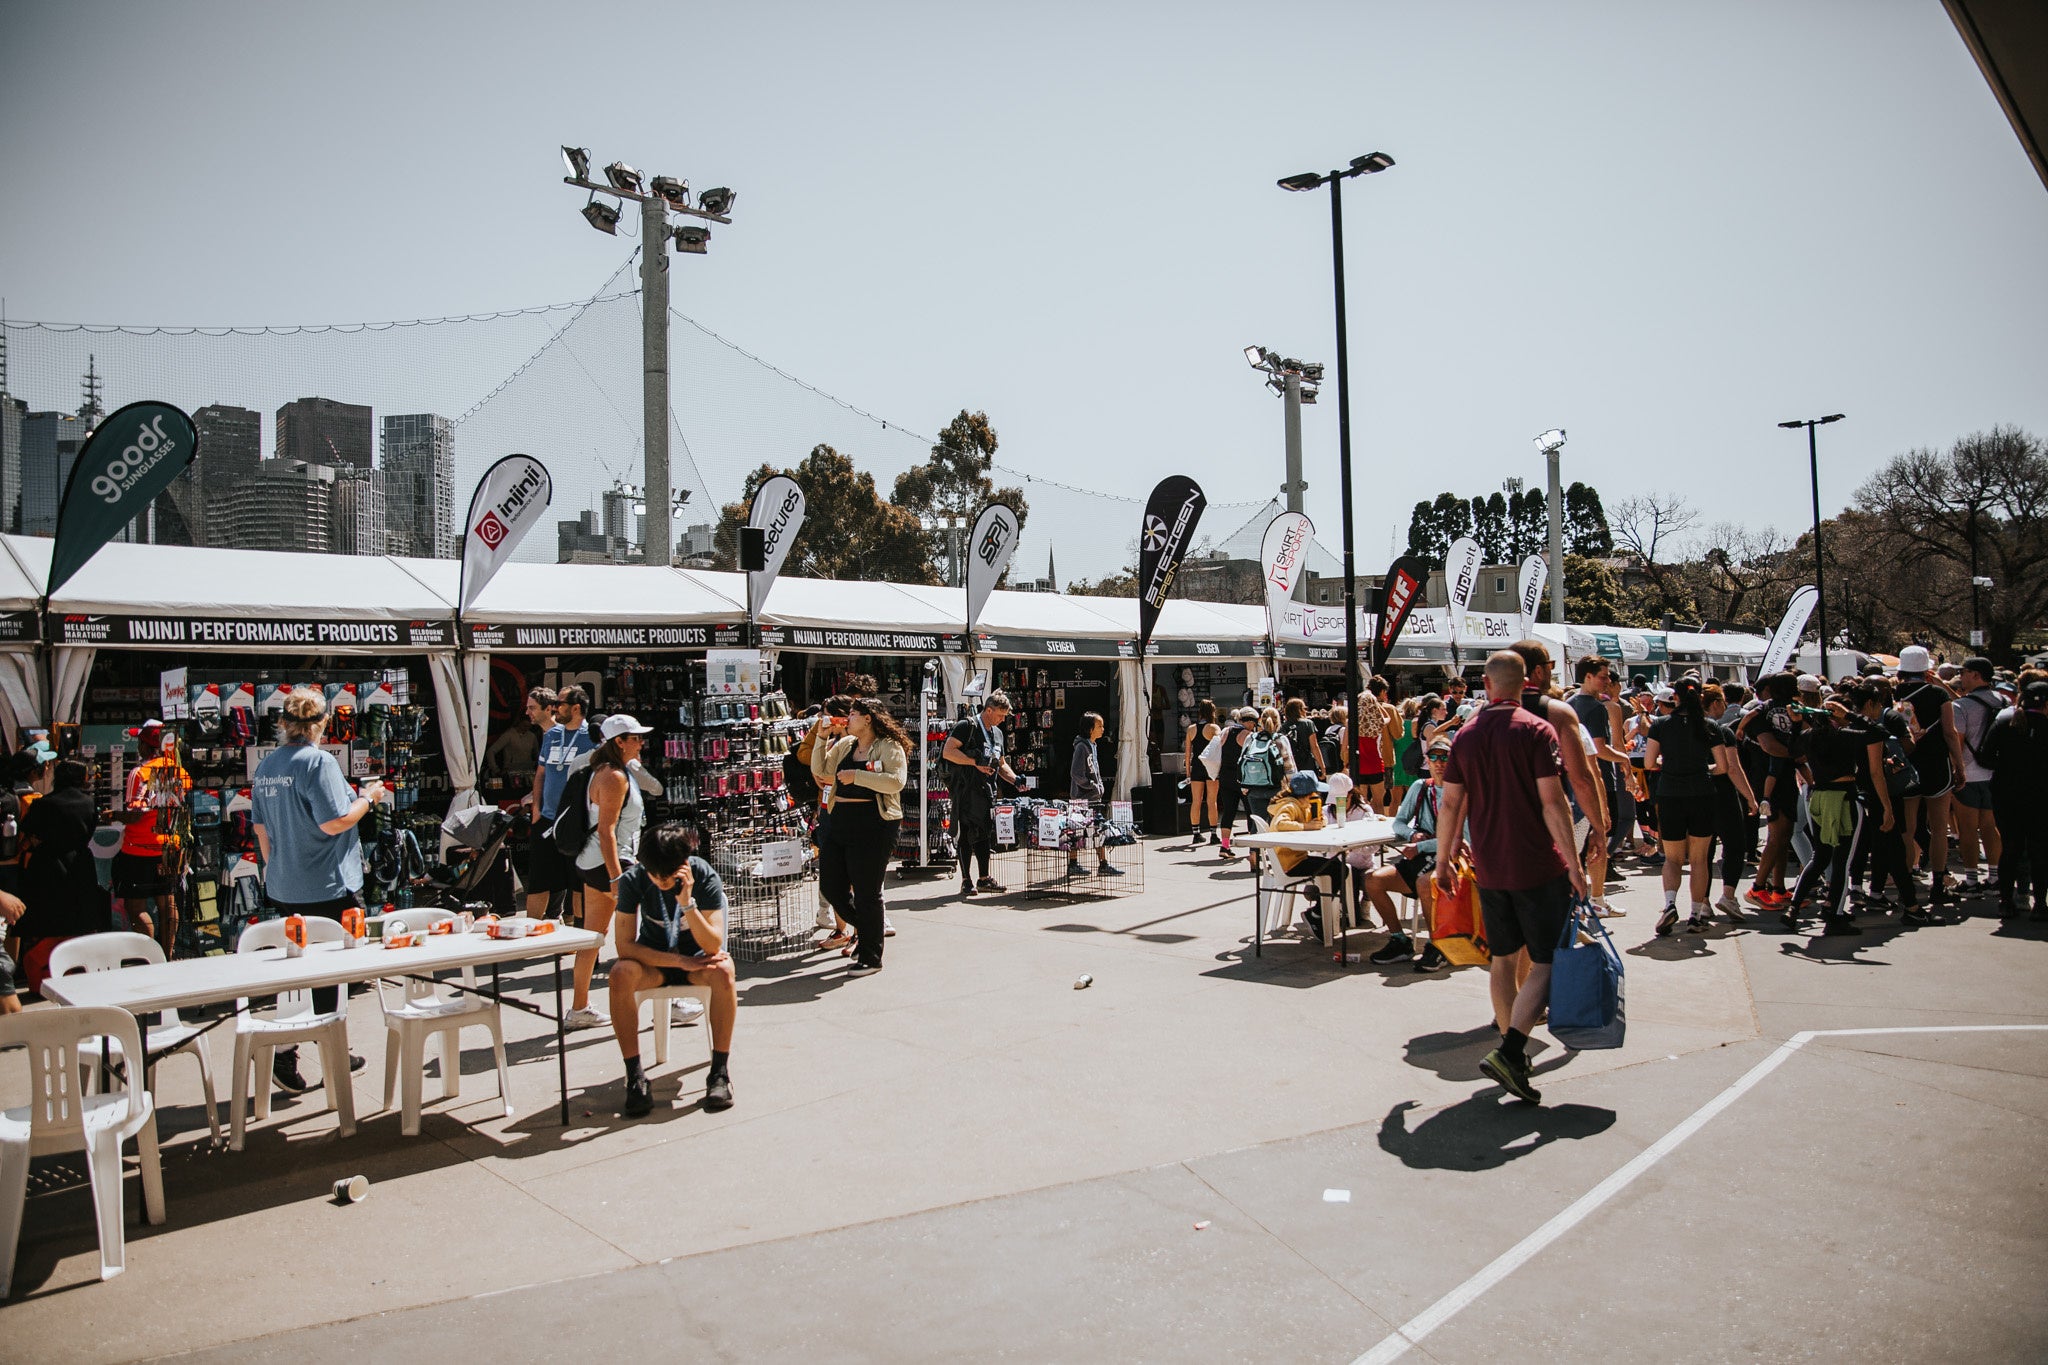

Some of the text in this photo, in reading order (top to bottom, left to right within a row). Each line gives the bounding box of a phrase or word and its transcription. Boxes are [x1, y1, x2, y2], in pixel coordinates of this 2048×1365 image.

[91, 414, 167, 504] goodr
[121, 438, 176, 492] SUNGLASSES
[497, 463, 540, 518] injinji
[979, 513, 1009, 566] SPI
[1145, 488, 1200, 605] STEIGEN
[1276, 526, 1297, 565] SKIRT
[1285, 519, 1309, 568] SPORTS
[1154, 560, 1179, 609] OPEN
[1453, 546, 1477, 606] FlipBelt
[1523, 559, 1541, 615] FlipBelt
[1384, 575, 1413, 637] CLIF
[64, 623, 111, 632] MELBOURNE
[65, 630, 107, 639] MARATHON
[128, 620, 398, 642] INJINJI PERFORMANCE PRODUCTS
[409, 628, 445, 636] MELBOURNE
[472, 631, 505, 639] MELBOURNE
[516, 628, 706, 645] INJINJI PERFORMANCE PRODUCTS
[1465, 616, 1510, 641] FlipBelt
[793, 630, 937, 650] INJINJI PERFORMANCE PRODUCTS
[1046, 641, 1076, 653] STEIGEN
[1196, 643, 1220, 654] STEIGEN
[1051, 680, 1107, 688] STEIGEN
[354, 762, 369, 770] $30
[265, 786, 278, 797] Life
